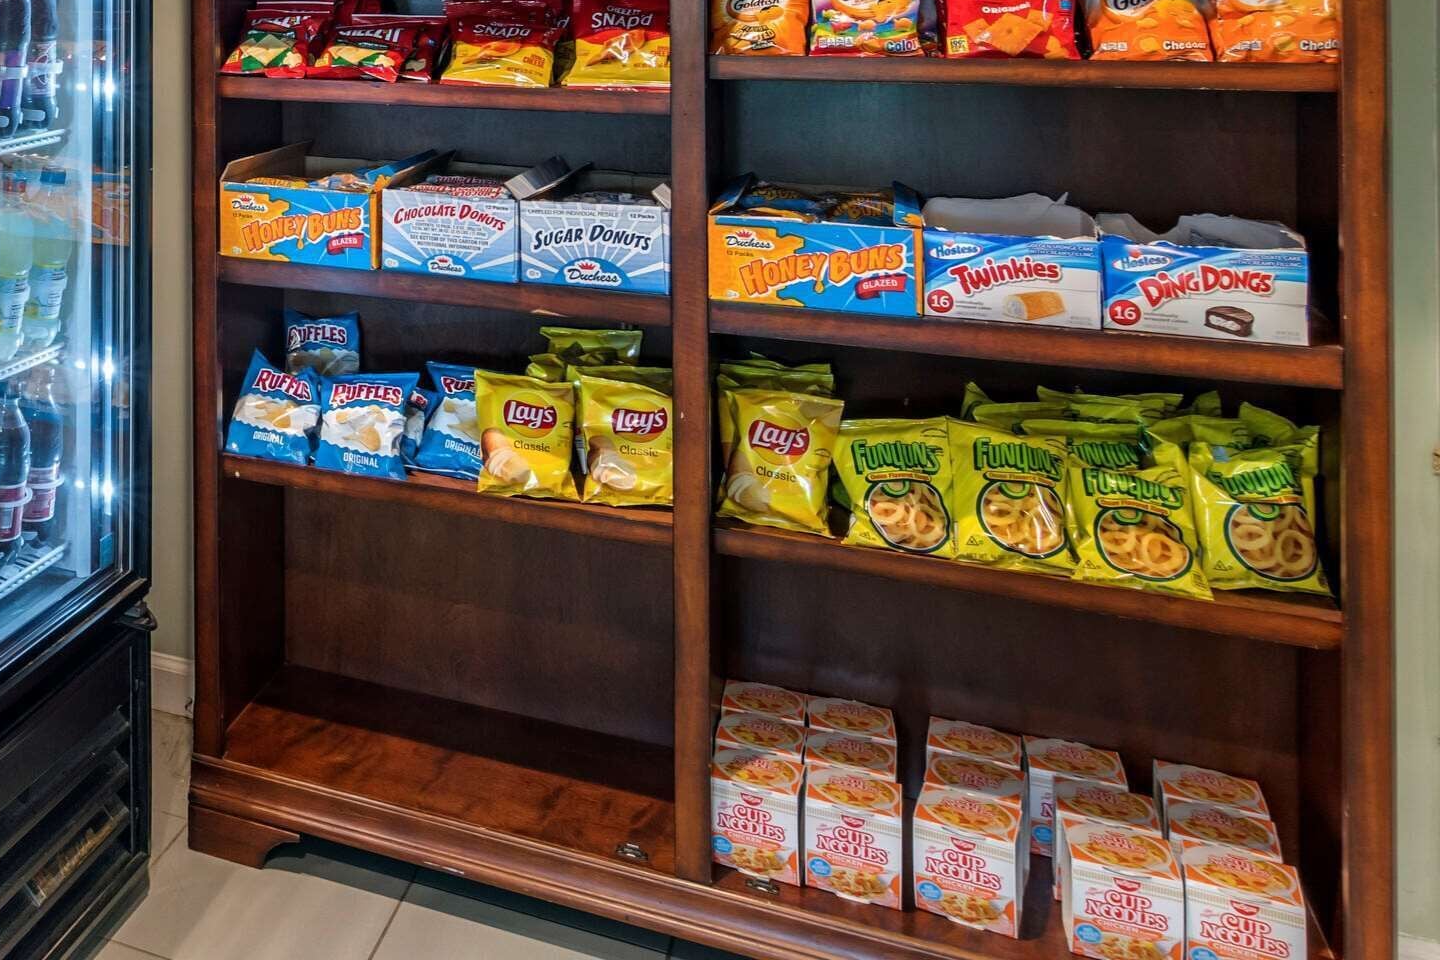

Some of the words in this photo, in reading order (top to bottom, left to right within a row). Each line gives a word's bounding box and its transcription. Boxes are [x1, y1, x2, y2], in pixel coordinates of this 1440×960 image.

[231, 199, 266, 212] Duchess
[394, 205, 456, 224] CHOCOLATE
[459, 204, 506, 231] DONUTS
[242, 214, 306, 252] HONEY
[306, 208, 363, 241] BUNS
[534, 229, 583, 249] SUGAR
[589, 225, 651, 250] DONUTS
[332, 238, 358, 247] GLAZED
[725, 235, 772, 249] Duchess
[935, 243, 978, 257] Hostess
[429, 262, 463, 273] Duchess
[739, 253, 826, 296] HONEY
[828, 245, 903, 283] BUNS
[1122, 256, 1168, 270] Hostess
[567, 268, 620, 283] Duchess
[862, 278, 898, 289] GLAZED
[950, 257, 1060, 294] Twinkies
[1200, 265, 1273, 293] DONGS
[931, 295, 949, 308] 16
[1114, 306, 1137, 320] 16
[331, 383, 403, 406] RUFFLES
[507, 401, 555, 429] Lay's
[615, 408, 667, 435] Lay's
[253, 431, 284, 445] ORIGINAL
[514, 440, 551, 453] Classic
[751, 420, 809, 456] Lay's
[343, 452, 379, 468] ORIGINAL
[620, 444, 659, 458] Classic
[755, 465, 796, 483] Classic
[733, 805, 772, 823] CUP
[717, 813, 785, 841] NOODLES
[833, 826, 873, 845] CUP
[816, 835, 888, 865] NOODLES
[943, 849, 985, 870] CUP
[926, 858, 1001, 890] NOODLES
[1104, 890, 1152, 911] CUP
[1084, 899, 1168, 932] NOODLES
[1221, 912, 1271, 935] CUP
[1201, 921, 1290, 959] NOODLES
